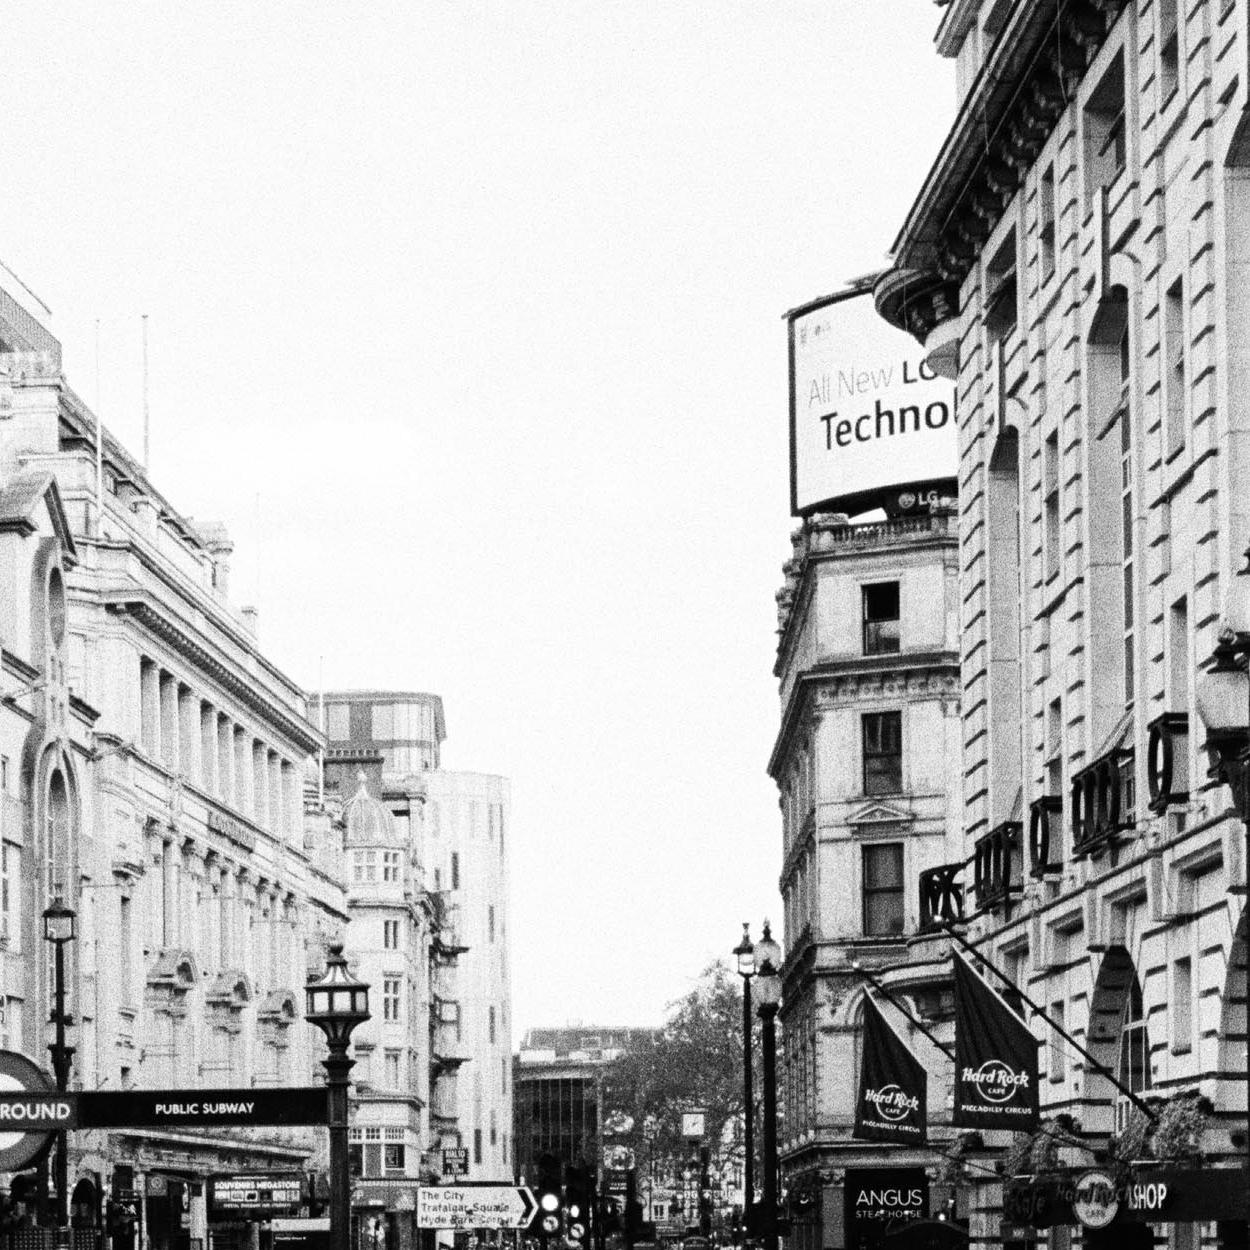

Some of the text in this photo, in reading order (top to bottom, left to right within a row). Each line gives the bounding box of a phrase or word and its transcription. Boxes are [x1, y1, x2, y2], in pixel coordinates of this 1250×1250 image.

[808, 375, 830, 408] All
[838, 366, 893, 396] New
[961, 1067, 1030, 1088] Hard Rock
[987, 1087, 1006, 1095] CAFE
[865, 1088, 919, 1111] Hard Rock
[155, 1102, 255, 1115] PUBLIC SUBWAY
[885, 1107, 901, 1115] CAFE
[961, 1104, 1032, 1114] PICCADILLY CIRCUS
[862, 1119, 921, 1133] PICCADILLY CIRCUS
[214, 1181, 300, 1190] SOUVENIRS MEGASTORE
[422, 1190, 465, 1202] The City
[856, 1189, 923, 1206] ANGUS
[1133, 1183, 1167, 1209] SHOP
[421, 1203, 510, 1214] Trafalgar Square
[856, 1210, 922, 1219] STEAHOSE
[421, 1216, 449, 1226] Hyde
